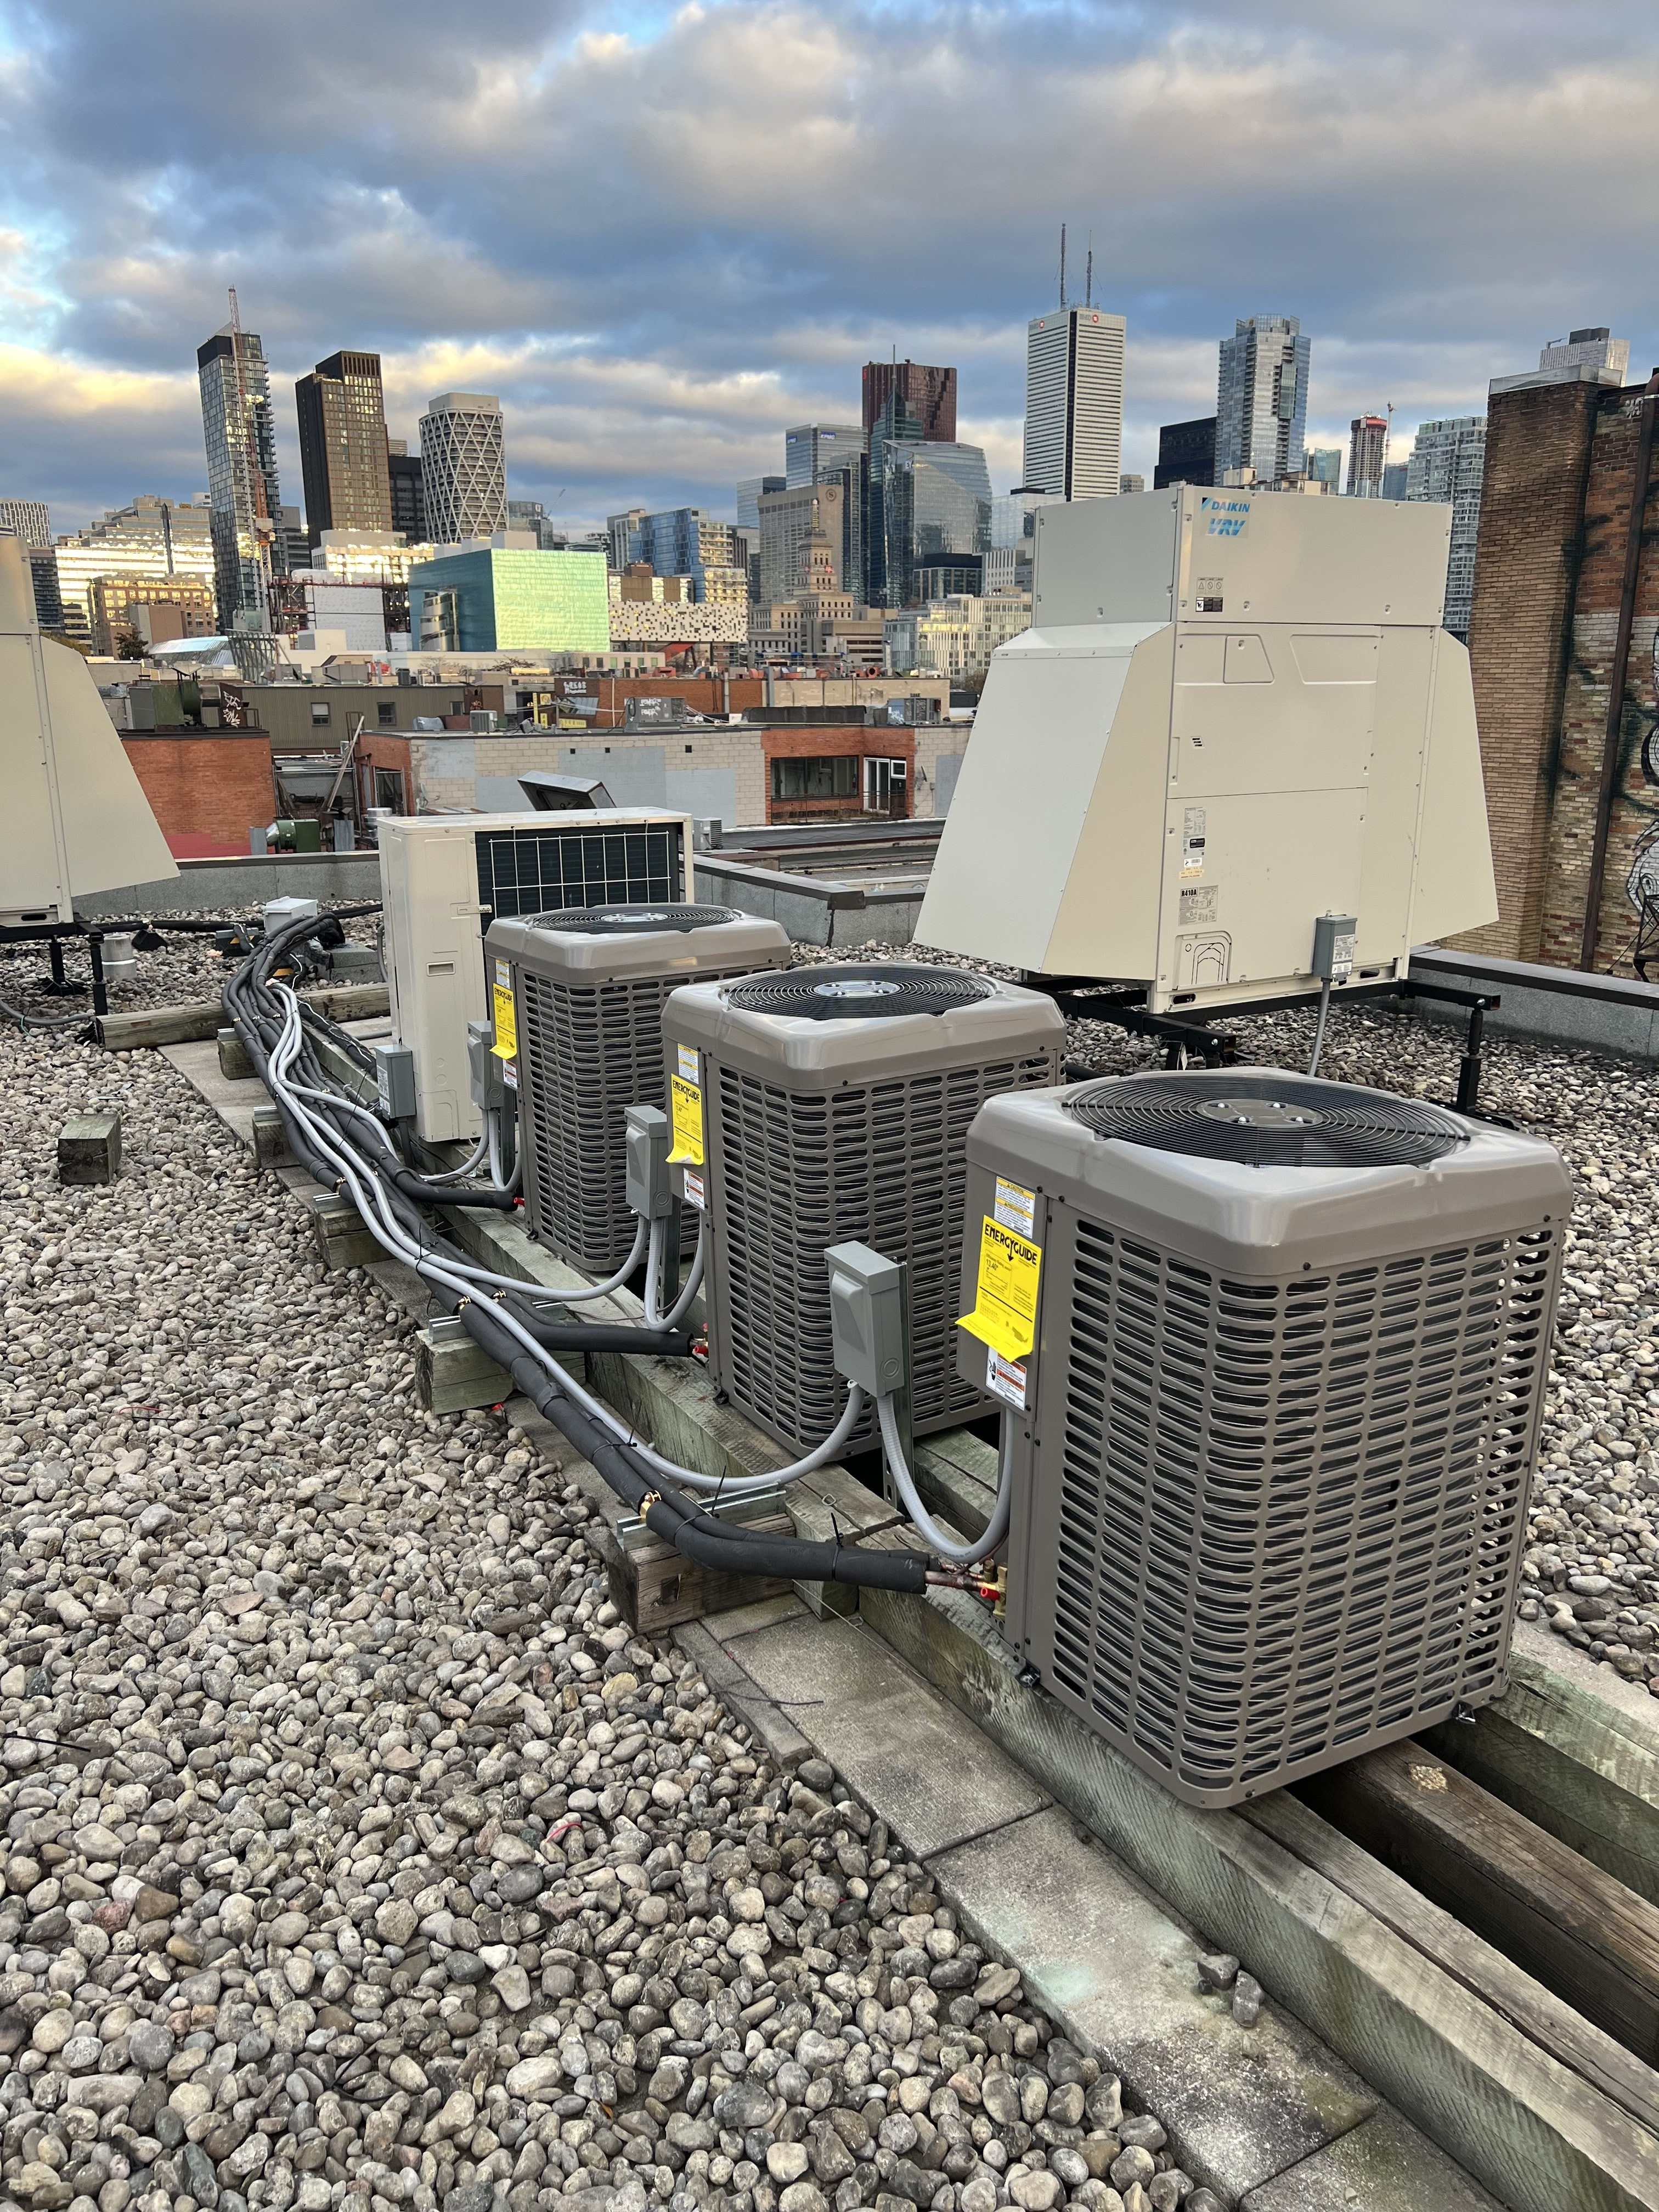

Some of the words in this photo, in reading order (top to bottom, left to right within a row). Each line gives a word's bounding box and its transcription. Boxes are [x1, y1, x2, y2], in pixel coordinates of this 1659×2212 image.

[1211, 501, 1250, 512] DAIKIN
[1207, 518, 1246, 535] VRV
[673, 1080, 699, 1102] ENERGYGUIDE
[984, 1223, 1038, 1266] ENERGYGUIDE
